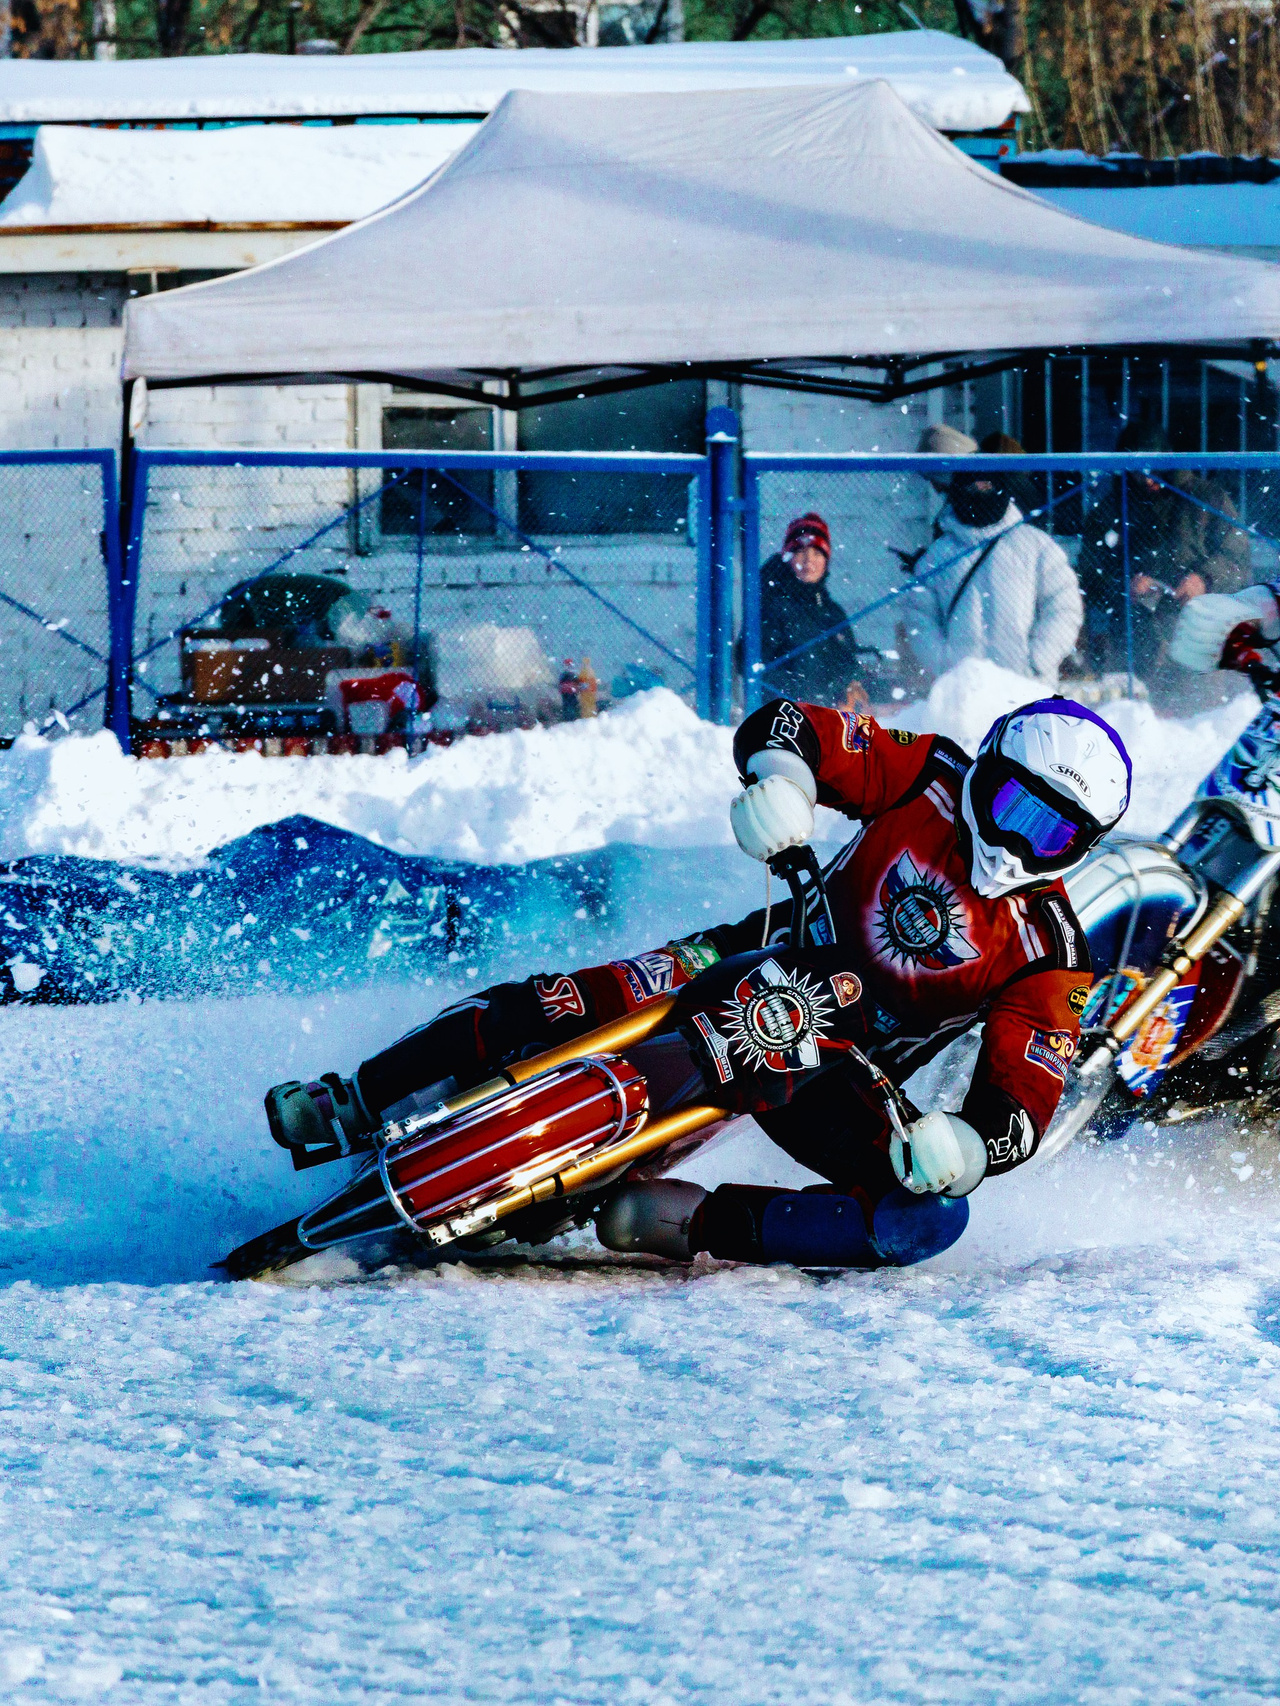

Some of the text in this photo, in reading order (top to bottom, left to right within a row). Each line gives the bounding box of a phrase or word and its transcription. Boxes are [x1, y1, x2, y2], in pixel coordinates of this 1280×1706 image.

[1056, 765, 1088, 793] SHOEI
[896, 910, 923, 943] ШААЗ
[901, 892, 941, 945] ТОРПЕДО
[625, 972, 644, 1002] ШААЗ
[1069, 991, 1087, 1007] OS
[746, 998, 757, 1030] Николая
[758, 1005, 781, 1038] ШААЗ
[764, 992, 797, 1042] ТОРПЕДО
[786, 990, 810, 1030] спортклуб
[751, 1030, 793, 1051] Красникова
[1030, 1044, 1068, 1076] ЧИСТОПРУДНЕ
